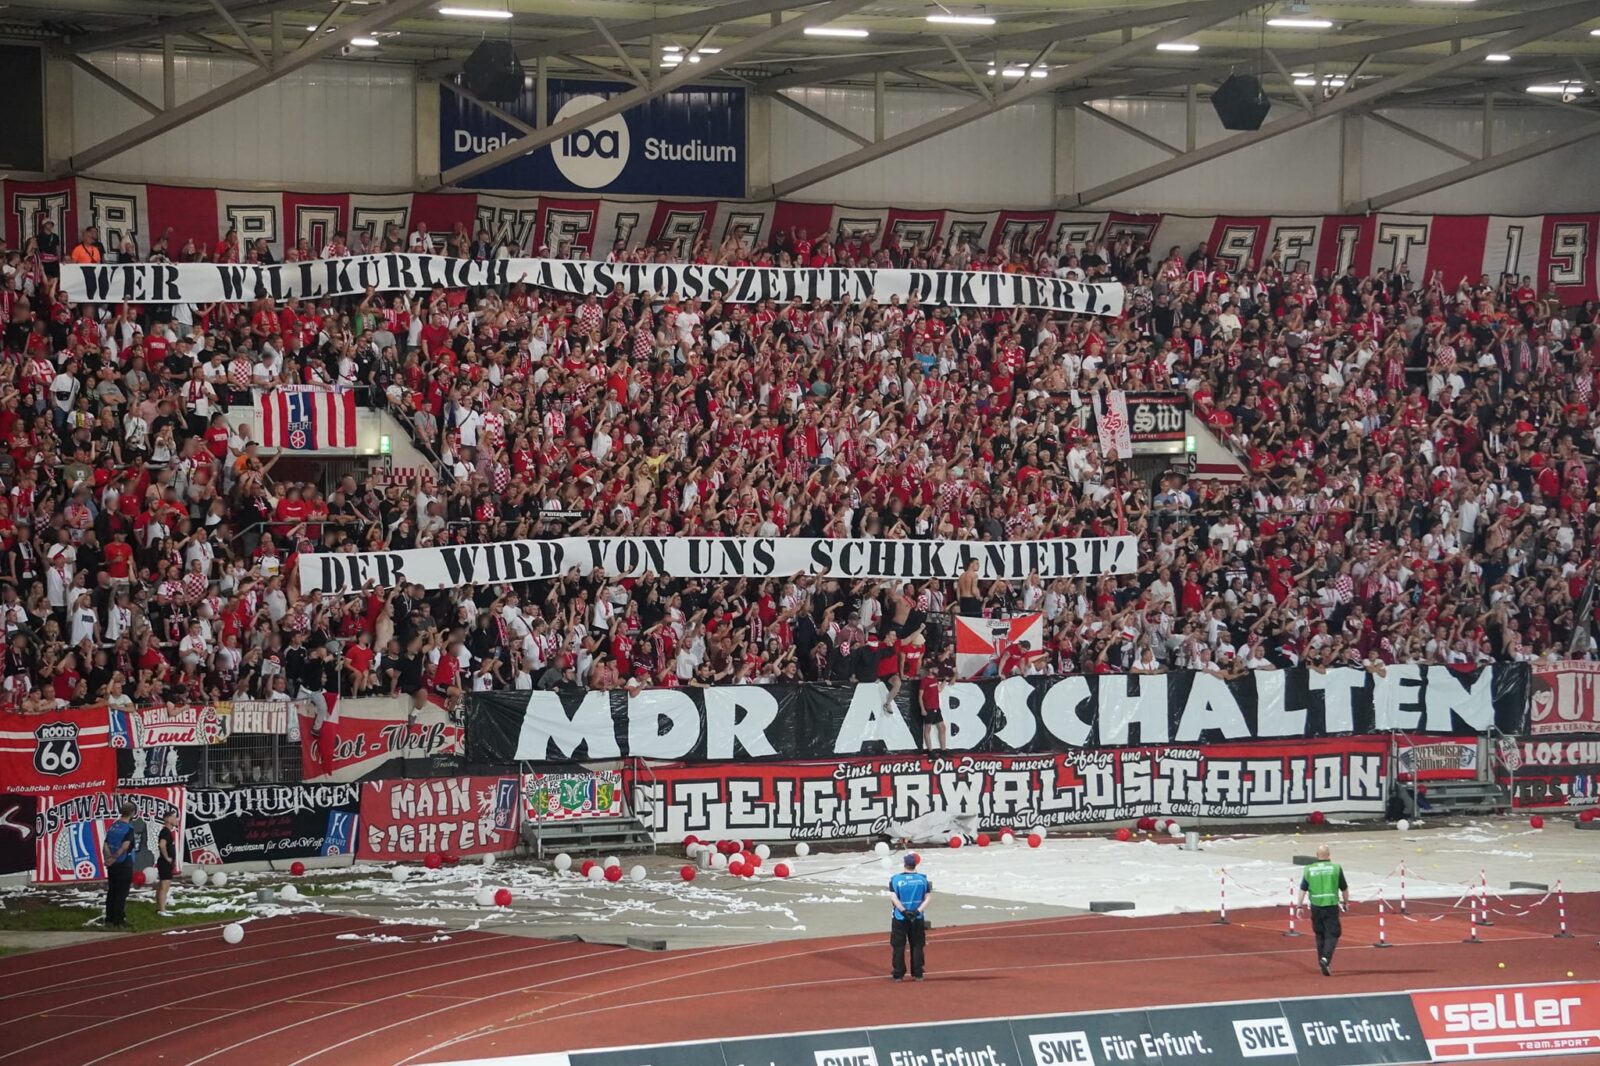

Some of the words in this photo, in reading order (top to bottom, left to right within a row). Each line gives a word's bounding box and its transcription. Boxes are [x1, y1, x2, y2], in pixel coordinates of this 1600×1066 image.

[562, 126, 620, 159] iba
[644, 137, 737, 163] Studium
[1215, 223, 1428, 279] SEIT
[80, 265, 181, 301] WER
[216, 254, 508, 301] WILLKÜRLICH
[536, 261, 878, 304] ANSTOSSZEITEN
[1133, 404, 1183, 432] Süd
[384, 457, 392, 476] R
[1189, 454, 1196, 473] S
[320, 553, 403, 594] DER
[440, 542, 564, 585] WIRD
[587, 539, 668, 575] VON
[689, 538, 775, 576] UNS
[810, 534, 1125, 578] SCHIKANIERT!
[234, 702, 287, 712] SPORTGRUPPE
[514, 685, 779, 761] MDR
[833, 664, 1496, 756] ABSCHALTEN
[42, 725, 76, 738] ROOTS
[233, 711, 287, 734] BERLIN
[145, 728, 196, 746] Land
[381, 721, 447, 755] Weiß
[41, 741, 78, 771] 66
[833, 762, 873, 780] Einst
[880, 760, 921, 774] warst
[933, 758, 953, 775] Du
[958, 757, 1002, 776] Zeuge
[1011, 759, 1055, 771] unserer
[1065, 751, 1113, 768] Erfolge
[1525, 742, 1563, 766] LOS
[6, 785, 50, 793] Fußballclub
[86, 780, 106, 789] Erfurt
[391, 777, 471, 820] MAIN
[632, 753, 1384, 831] STEIGERWALDSTADION
[331, 812, 349, 839] FC
[980, 814, 1014, 828] alten
[1015, 809, 1059, 827] Tage
[1064, 808, 1106, 822] werden
[1113, 806, 1137, 818] wir
[1171, 802, 1200, 816] ewig
[1207, 800, 1249, 816] sehnen
[188, 833, 214, 849] RWE
[190, 826, 205, 838] FC
[368, 818, 500, 853] FIGHTER
[790, 821, 822, 837] nach
[831, 819, 858, 835] dem
[220, 843, 264, 858] Gemeinsam
[264, 839, 277, 853] für
[278, 837, 325, 850] Rot-Weiß
[325, 837, 347, 847] ERFURT
[1037, 1039, 1086, 1064] SWE
[1099, 1035, 1138, 1061] Für
[1142, 1030, 1213, 1059] Erfurt.
[1240, 1025, 1289, 1050] SWE
[1301, 1021, 1339, 1046] Für
[1340, 1018, 1411, 1044] Erfurt.
